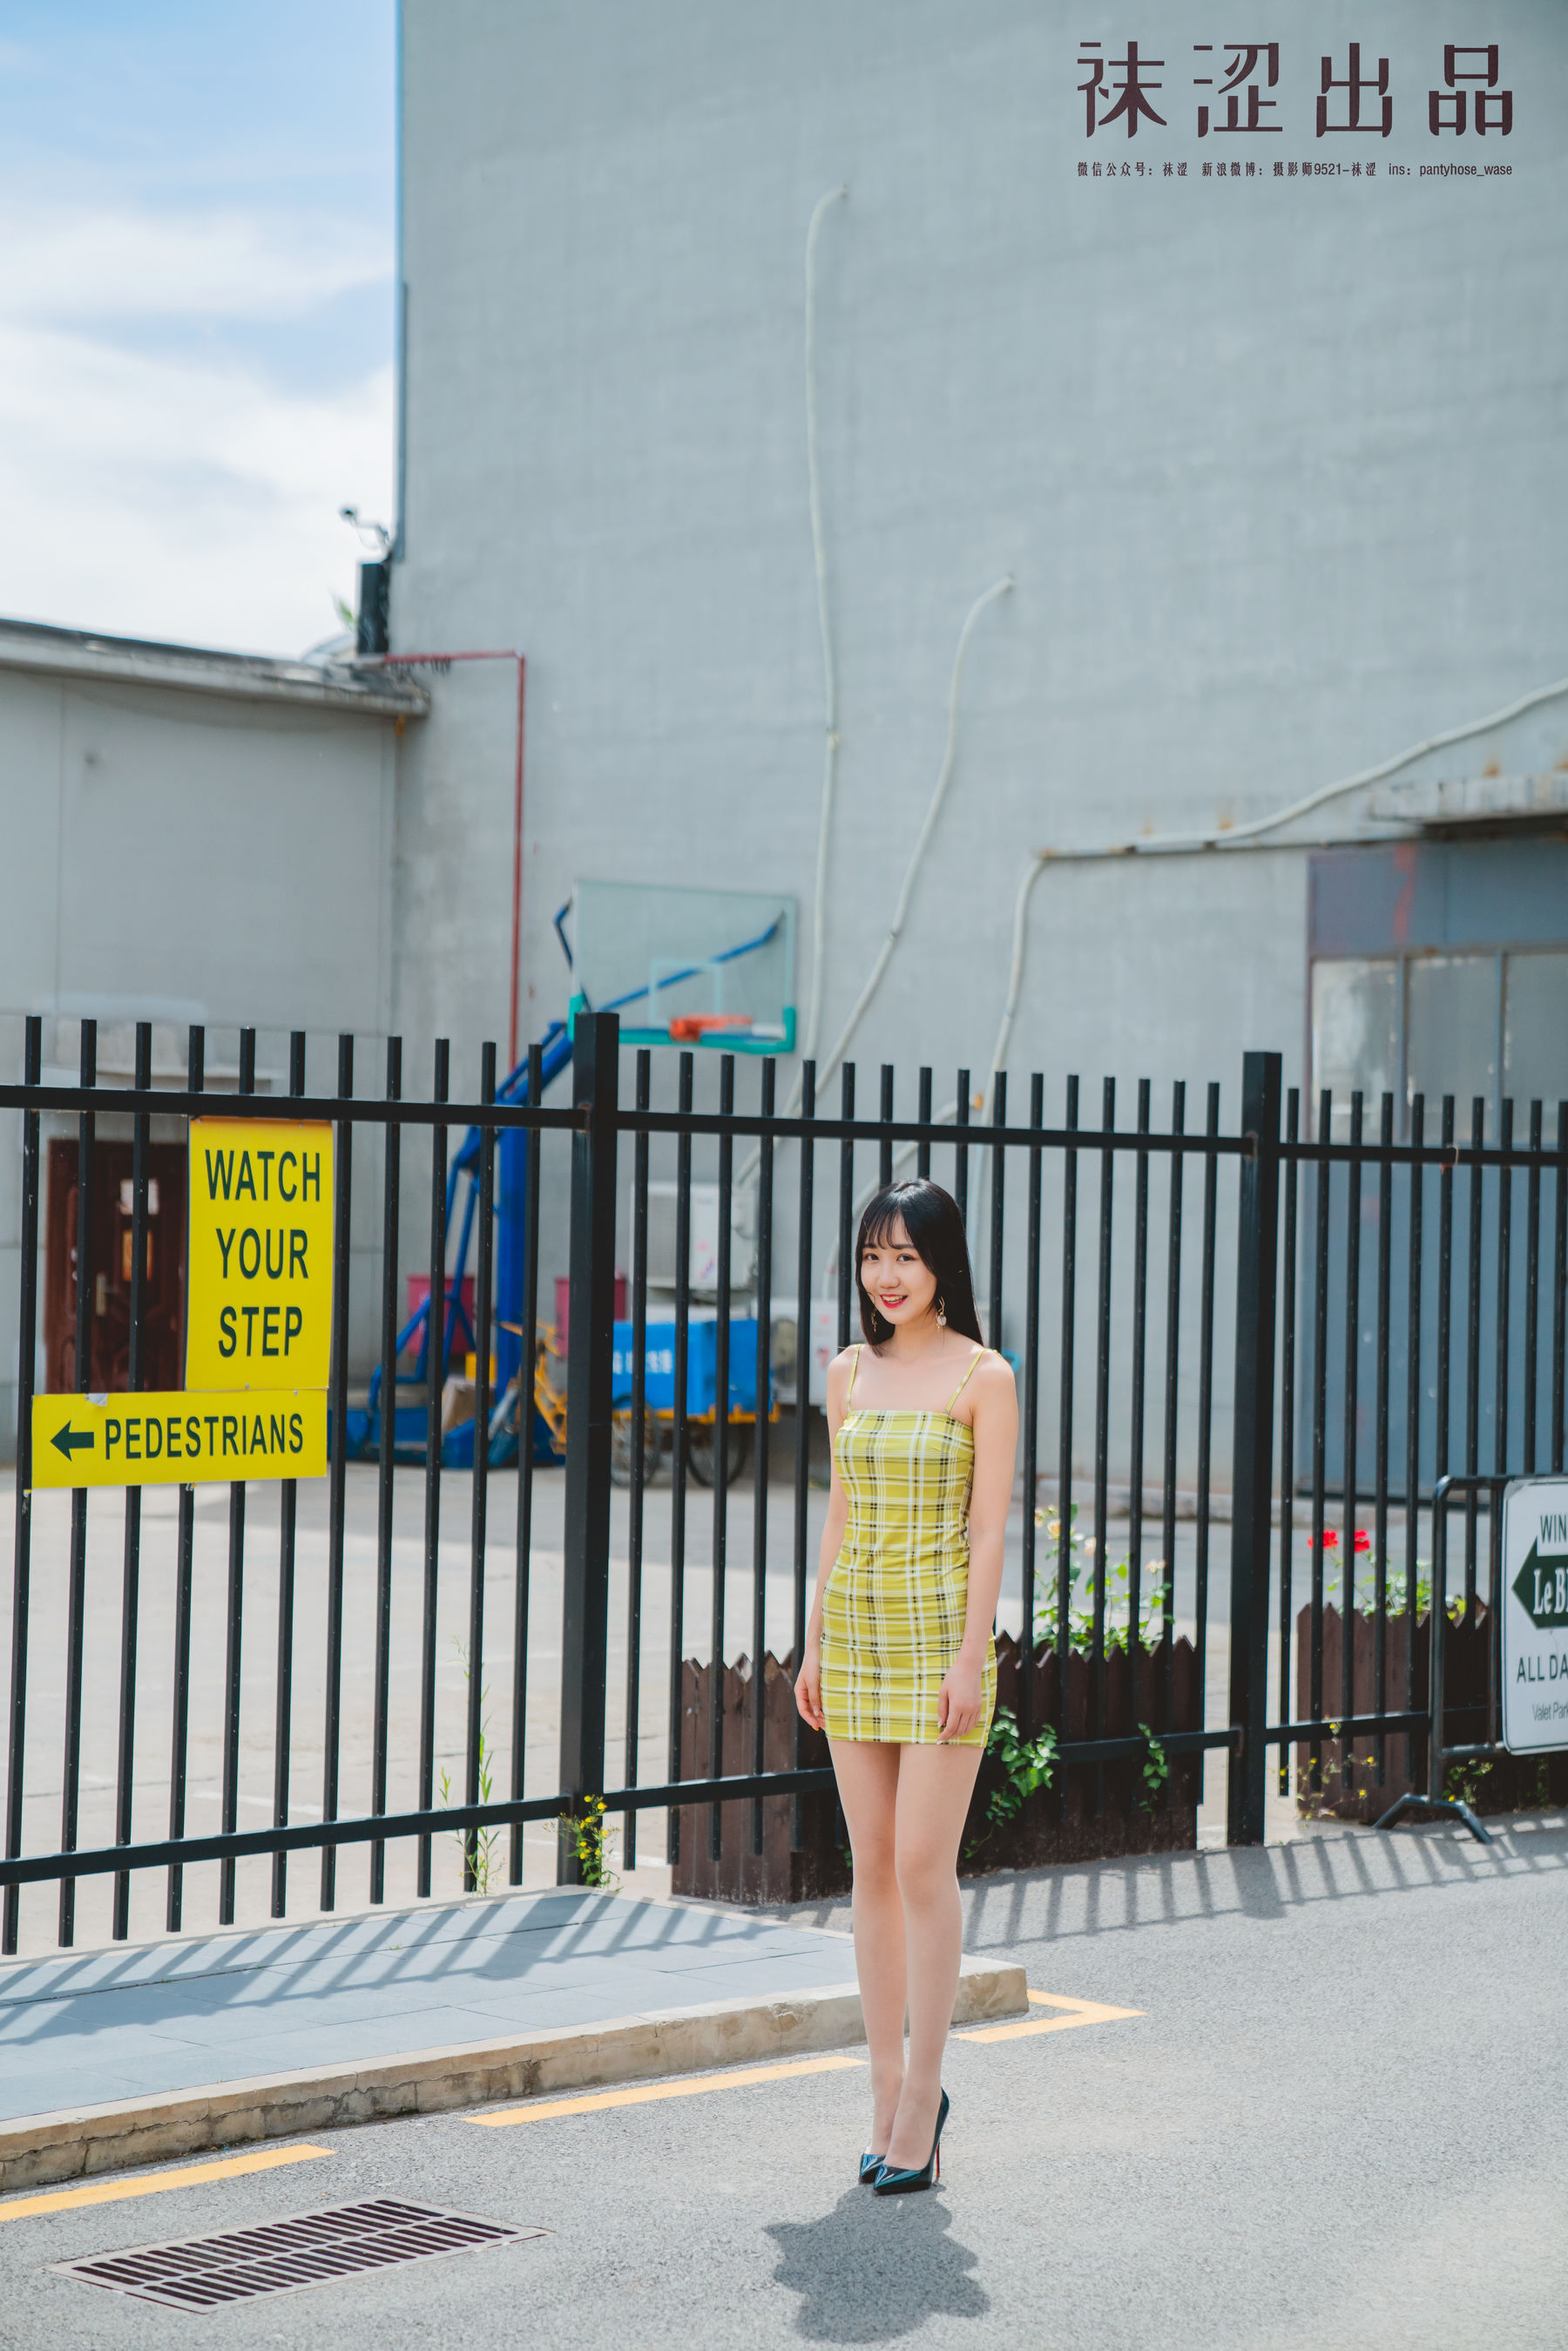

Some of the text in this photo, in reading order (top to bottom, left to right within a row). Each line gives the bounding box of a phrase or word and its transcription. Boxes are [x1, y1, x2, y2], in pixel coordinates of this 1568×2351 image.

[205, 1149, 321, 1203] WATCH
[215, 1228, 308, 1280] YOUR
[218, 1305, 303, 1358] STEP
[105, 1413, 303, 1460] PEDESTRIANS
[1517, 1656, 1545, 1684] ALL
[1532, 1704, 1551, 1721] Valet
